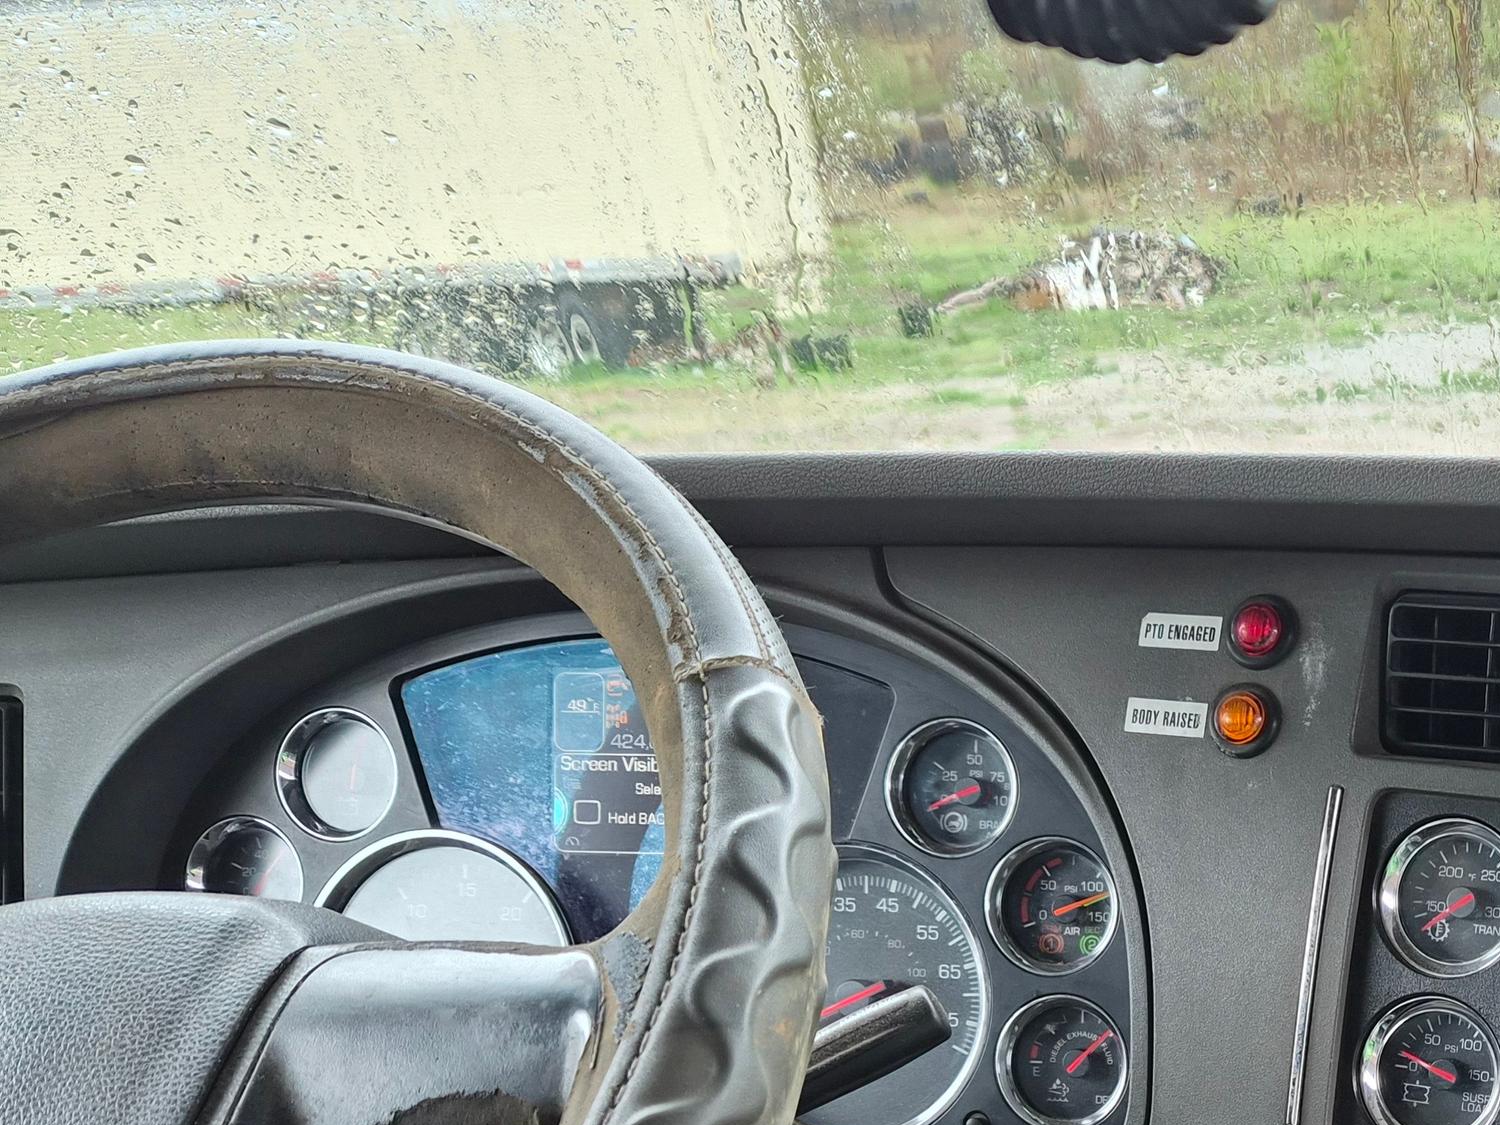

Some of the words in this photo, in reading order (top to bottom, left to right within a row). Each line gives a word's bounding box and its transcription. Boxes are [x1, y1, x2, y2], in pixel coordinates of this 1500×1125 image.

[1144, 623, 1164, 639] PTO
[1168, 624, 1216, 642] ENGAGED
[1132, 709, 1159, 725] BODY
[1163, 711, 1200, 729] RAISED
[560, 756, 618, 771] Screen
[622, 756, 660, 772] Visib
[967, 754, 983, 765] 50
[942, 771, 958, 781] 25
[990, 772, 1005, 782] 75
[635, 782, 661, 795] Sele
[608, 812, 636, 825] Hold
[639, 812, 665, 825] BAC
[1438, 866, 1463, 878] 200
[1040, 880, 1057, 891] 50
[1064, 885, 1078, 893] PSI
[1080, 881, 1104, 892] 100
[834, 897, 856, 912] 35
[876, 897, 899, 913] 45
[1426, 900, 1446, 912] 150
[1039, 910, 1047, 920] 0
[1089, 911, 1111, 922] 150
[916, 925, 939, 940] 55
[1064, 926, 1081, 936] AIR
[907, 968, 926, 978] 100
[938, 964, 961, 979] 65
[949, 1012, 959, 1027] 5
[1424, 1034, 1441, 1046] 50
[1460, 1038, 1482, 1051] 100
[1050, 1039, 1066, 1063] DIESEL
[1067, 1031, 1101, 1041] EXHAUS
[1101, 1042, 1114, 1065] FLUID
[1444, 1044, 1459, 1053] PSI
[1409, 1061, 1418, 1072] 0
[1468, 1069, 1490, 1082] 150
